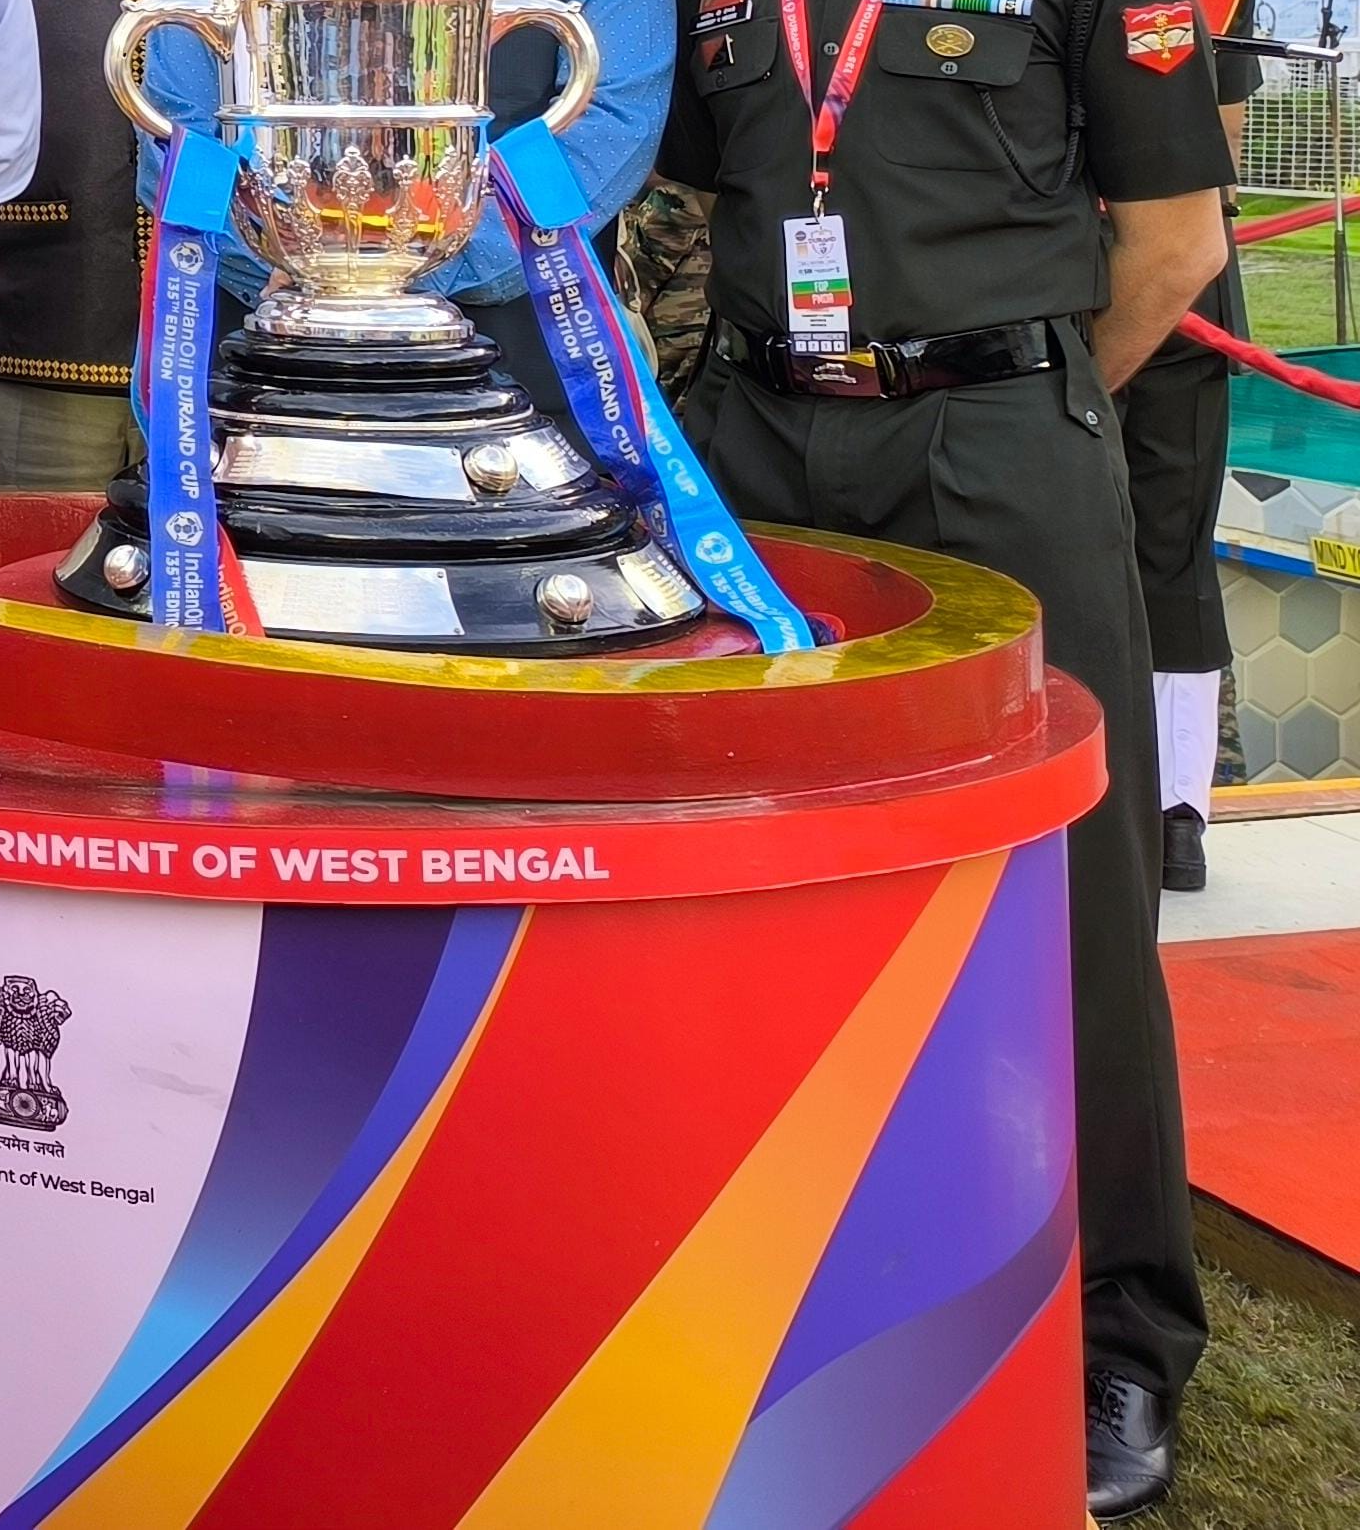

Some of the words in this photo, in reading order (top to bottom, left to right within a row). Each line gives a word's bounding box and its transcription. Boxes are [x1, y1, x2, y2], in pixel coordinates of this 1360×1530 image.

[855, 4, 875, 48] EDITION
[794, 51, 805, 71] CUP
[166, 277, 180, 313] 135TH
[534, 254, 560, 291] 135TH
[548, 294, 582, 359] EDITION
[178, 280, 201, 370] IndianOil
[160, 314, 178, 380] EDITION
[550, 248, 599, 339] IndianOil
[586, 340, 621, 422] DURAND
[611, 424, 640, 466] CUP
[177, 375, 196, 456] DURAND
[180, 460, 199, 500] CUP
[667, 458, 699, 497] CUP
[165, 550, 181, 588] 135TH
[192, 845, 257, 879] OF
[270, 847, 408, 883] WEST
[421, 846, 610, 884] BENGAL
[33, 1141, 65, 1159] जयते
[20, 1172, 38, 1187] of
[40, 1174, 86, 1195] West
[91, 1181, 155, 1205] Bengal
